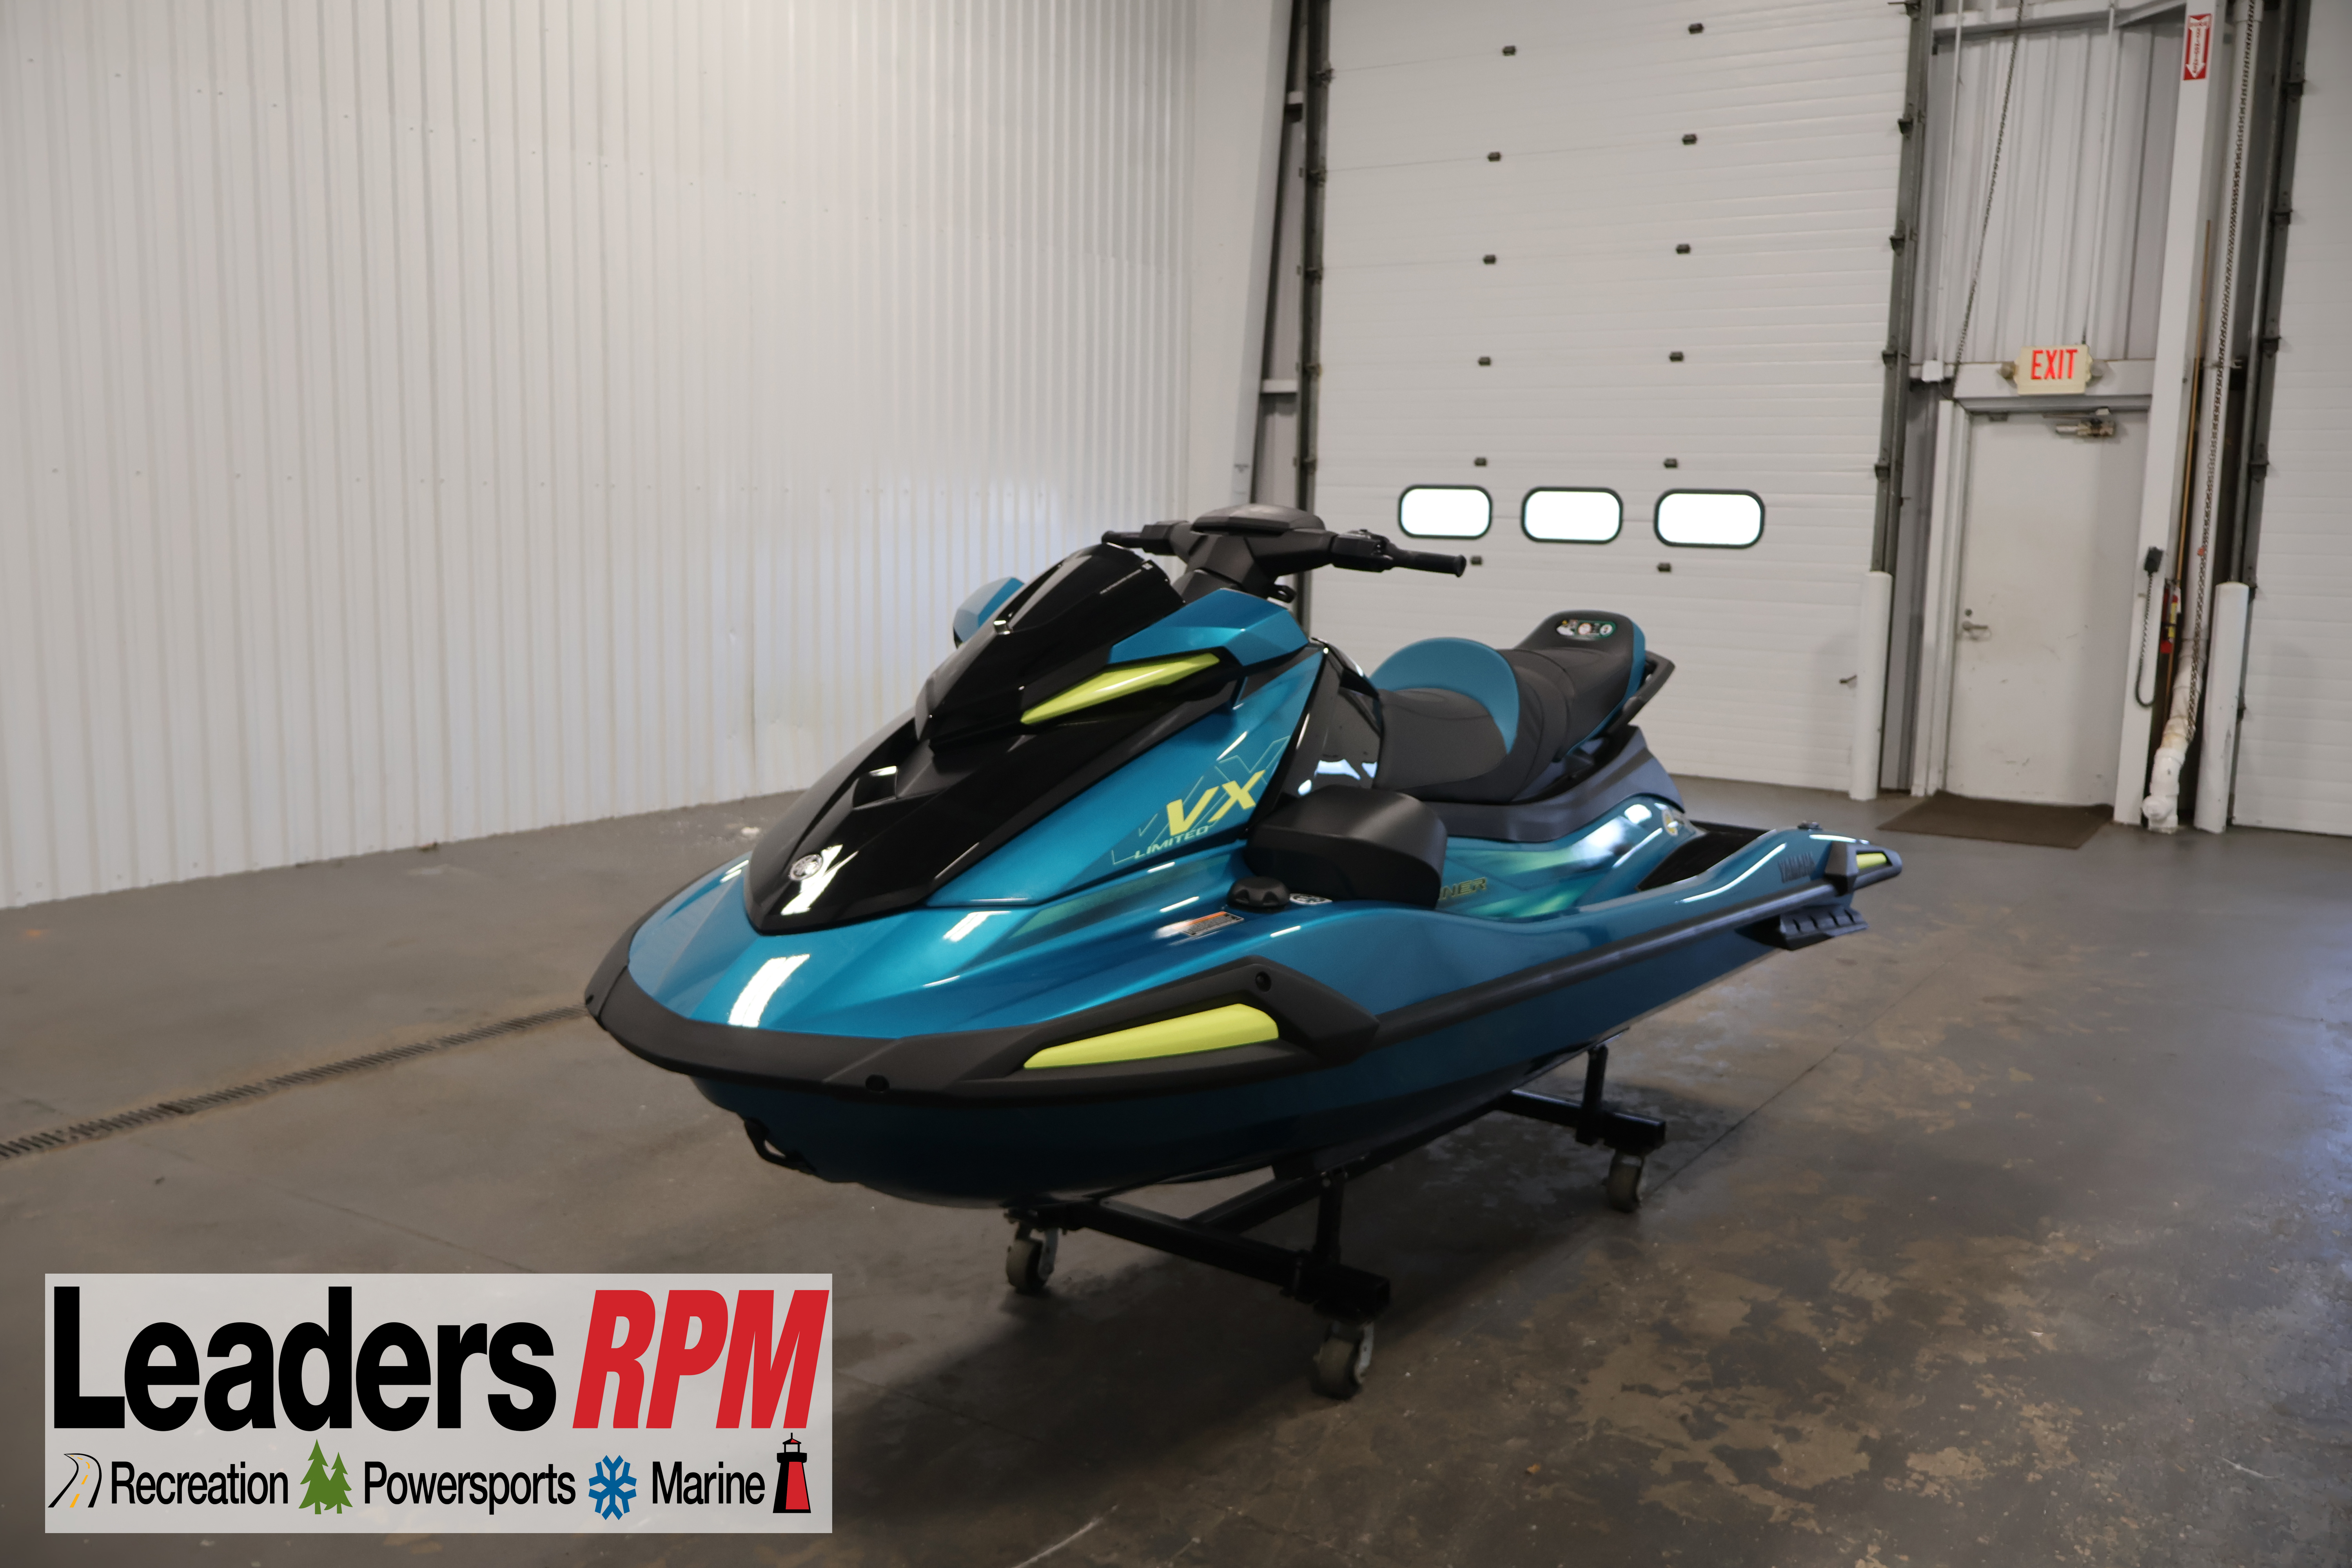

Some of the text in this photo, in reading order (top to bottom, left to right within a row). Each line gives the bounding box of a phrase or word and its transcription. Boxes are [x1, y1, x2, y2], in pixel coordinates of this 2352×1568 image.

[2031, 348, 2078, 380] EXIT
[1166, 769, 1266, 836] VX
[1134, 825, 1209, 859] LIMITED
